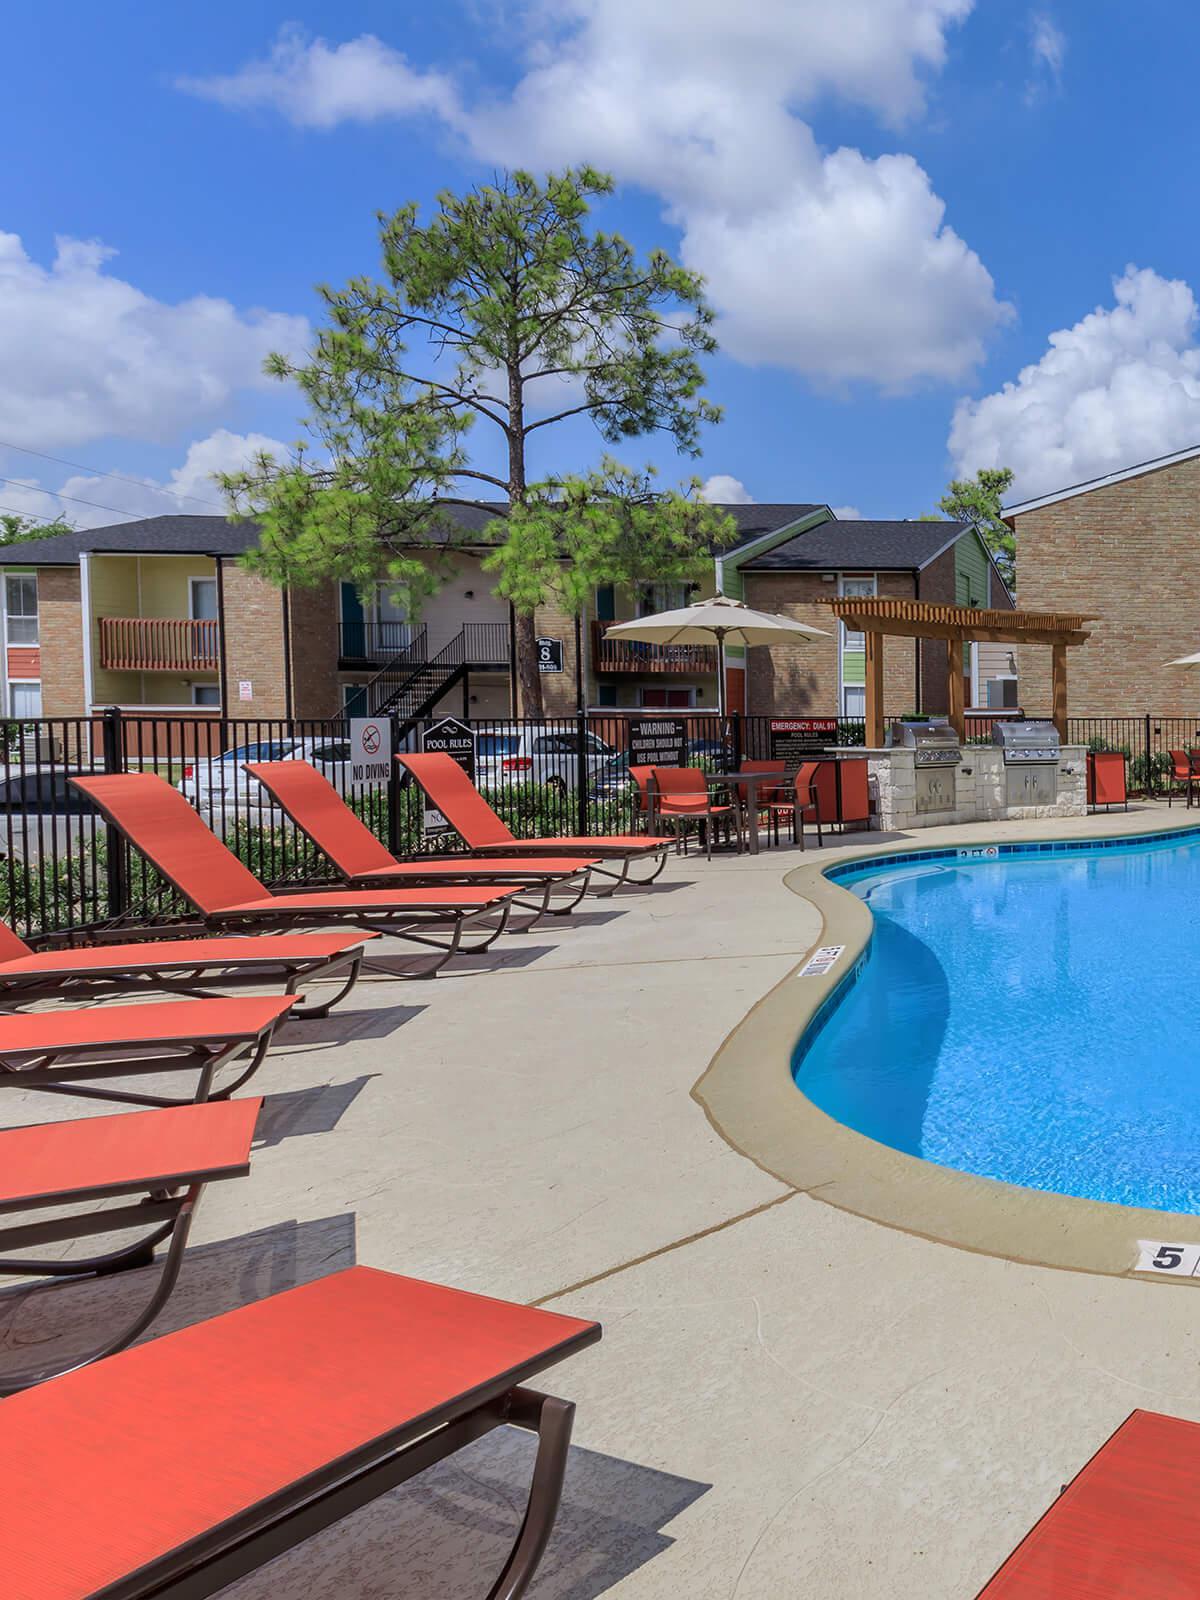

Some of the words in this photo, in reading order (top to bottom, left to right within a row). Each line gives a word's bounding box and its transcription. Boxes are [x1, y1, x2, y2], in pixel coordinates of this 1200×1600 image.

[541, 647, 550, 660] 8
[640, 722, 675, 735] WARNING
[771, 722, 810, 730] EMERGENCY:
[813, 722, 826, 730] DIAL
[827, 722, 836, 730] 911
[427, 740, 448, 749] POOL
[449, 738, 472, 749] RULES
[632, 739, 655, 750] CHILDREN
[656, 738, 673, 748] SHOULD
[674, 737, 683, 748] NOT
[636, 752, 646, 763] USE
[647, 752, 659, 762] POOL
[659, 751, 679, 761] WITHOUT
[353, 766, 363, 780] NO
[366, 764, 389, 779] DIVING
[1152, 1246, 1185, 1270] 5
